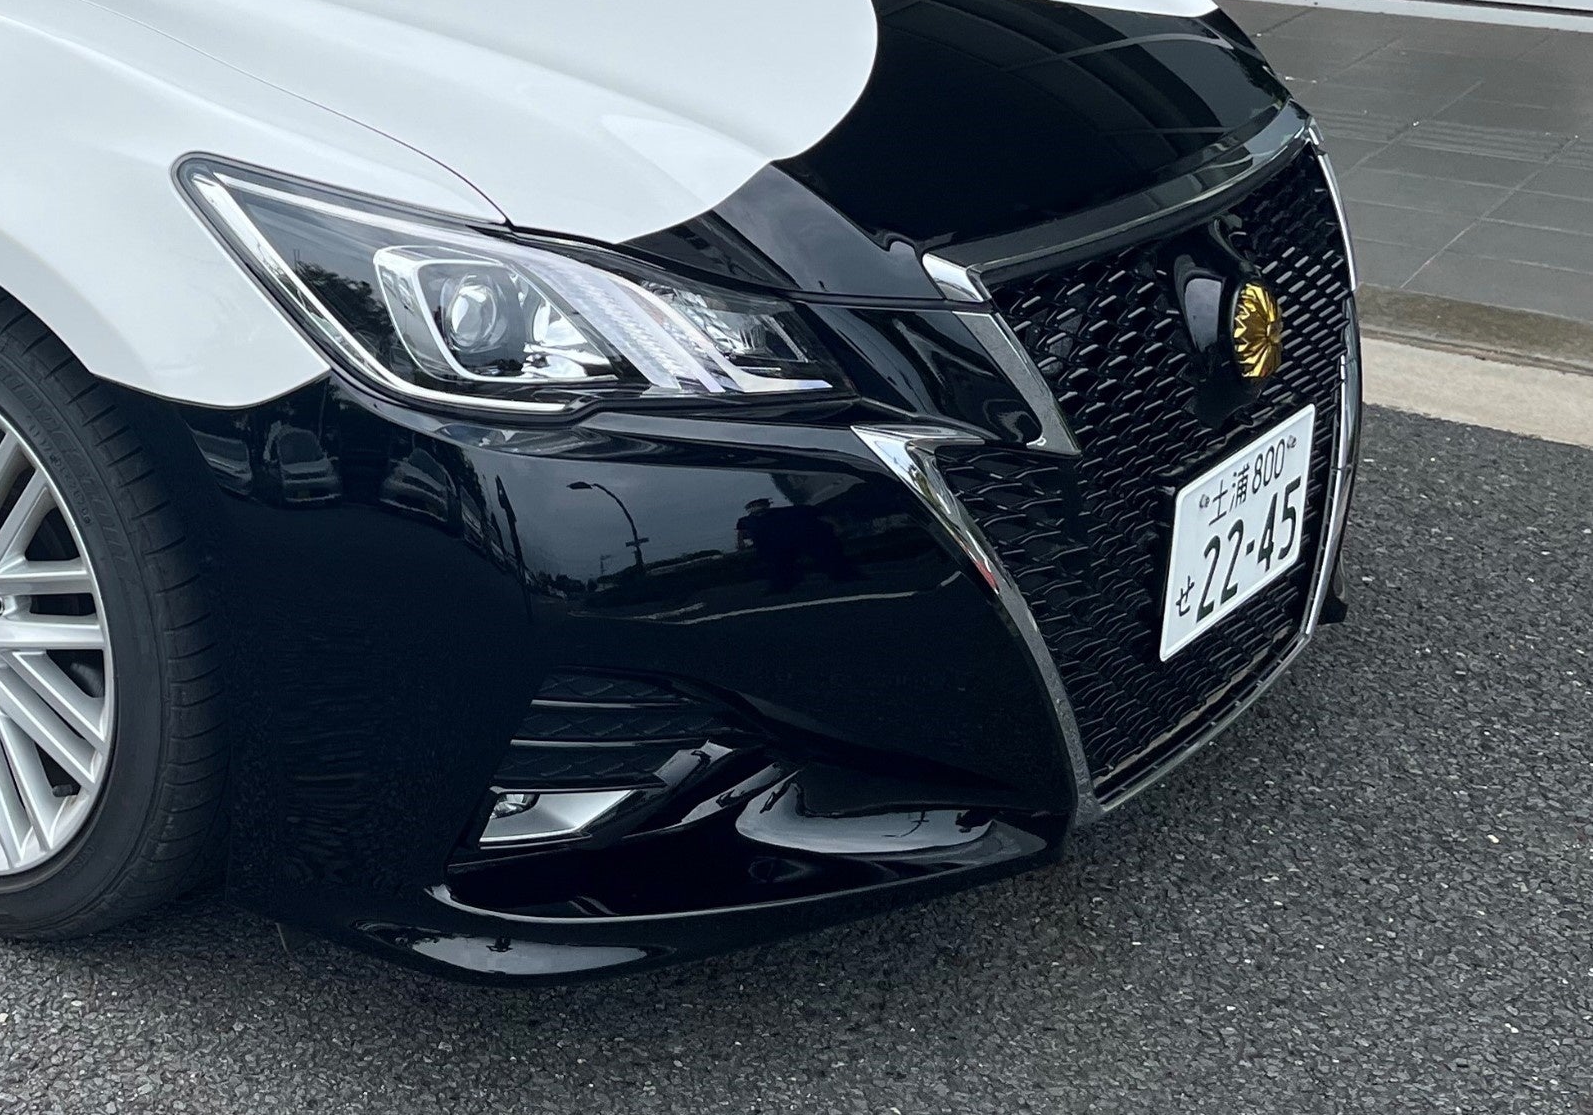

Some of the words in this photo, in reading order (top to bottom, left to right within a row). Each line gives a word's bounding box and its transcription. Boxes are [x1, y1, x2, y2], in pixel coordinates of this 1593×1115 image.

[1208, 462, 1250, 526] 土浦
[1252, 438, 1286, 495] 800
[1175, 575, 1195, 617] せ
[1195, 476, 1302, 624] 22-45
